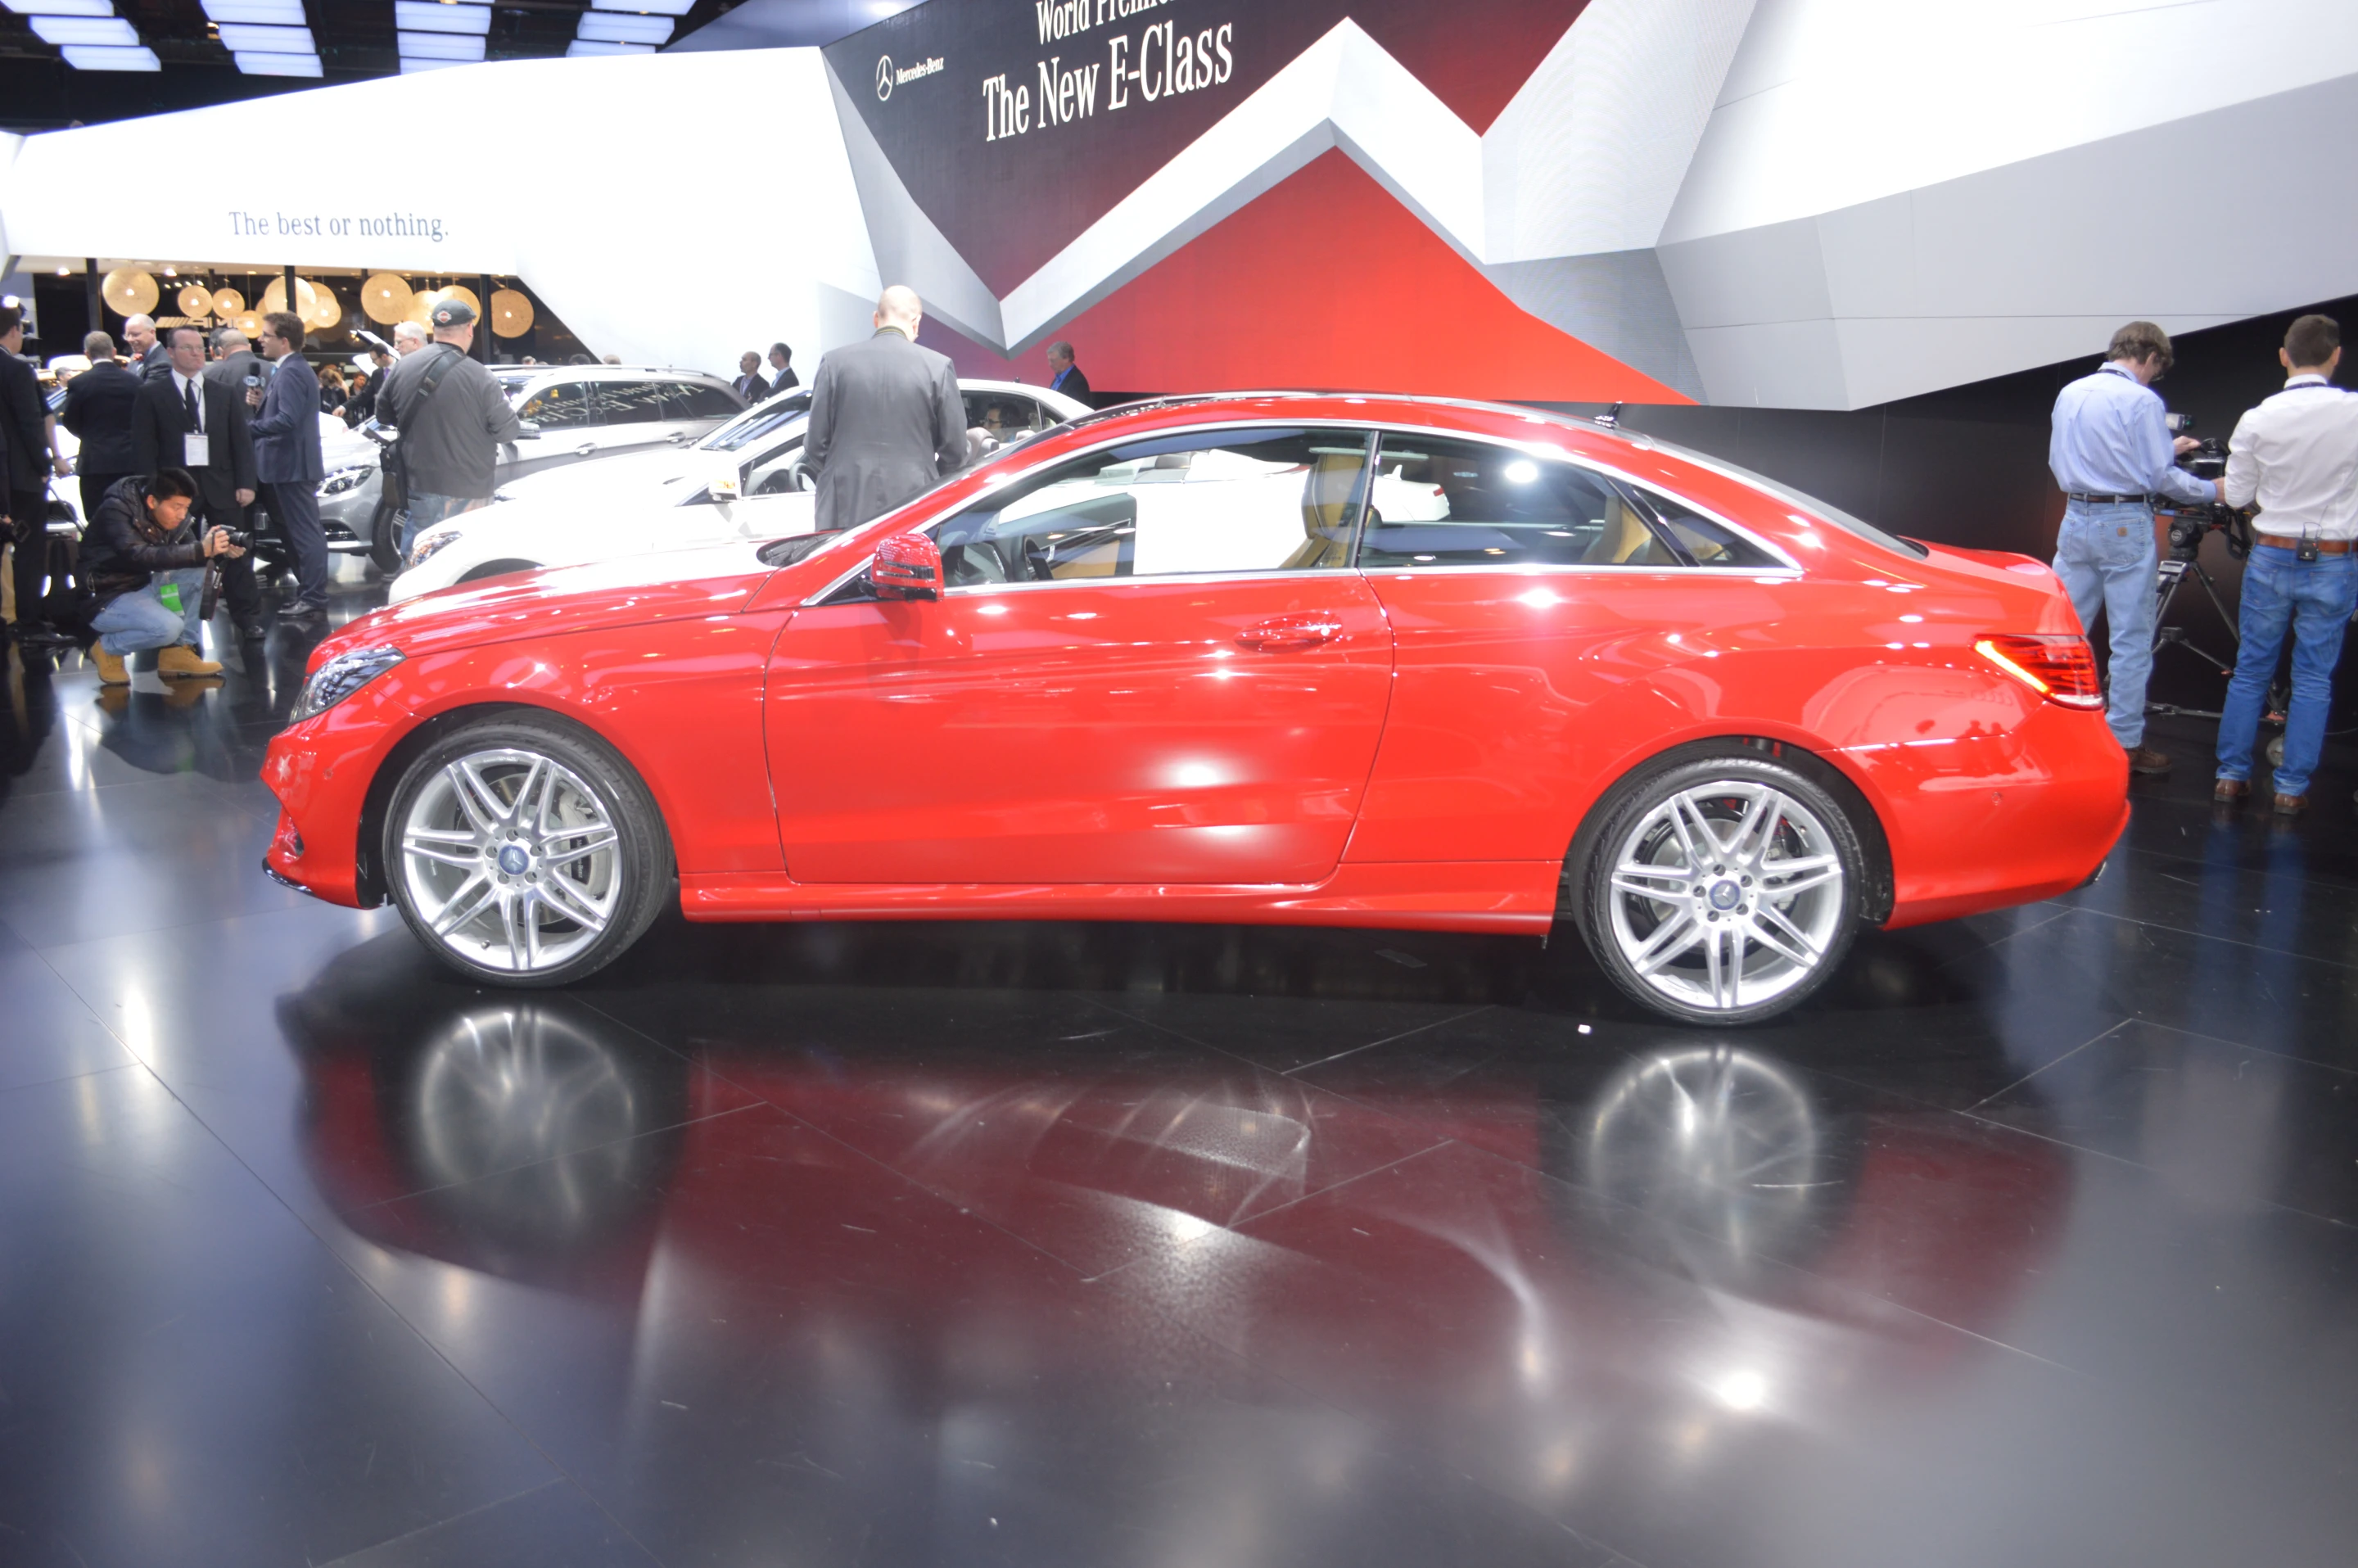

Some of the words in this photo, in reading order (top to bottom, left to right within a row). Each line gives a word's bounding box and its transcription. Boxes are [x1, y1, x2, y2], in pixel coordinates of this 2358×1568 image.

[1036, 0, 1091, 45] World
[896, 56, 944, 85] Mercedes-Benz
[983, 72, 1030, 142] The
[1037, 56, 1100, 129] New
[1108, 21, 1233, 111] E-Class
[228, 211, 269, 236] The
[276, 211, 322, 236] best
[329, 217, 351, 236] or
[359, 212, 449, 242] nothing.
